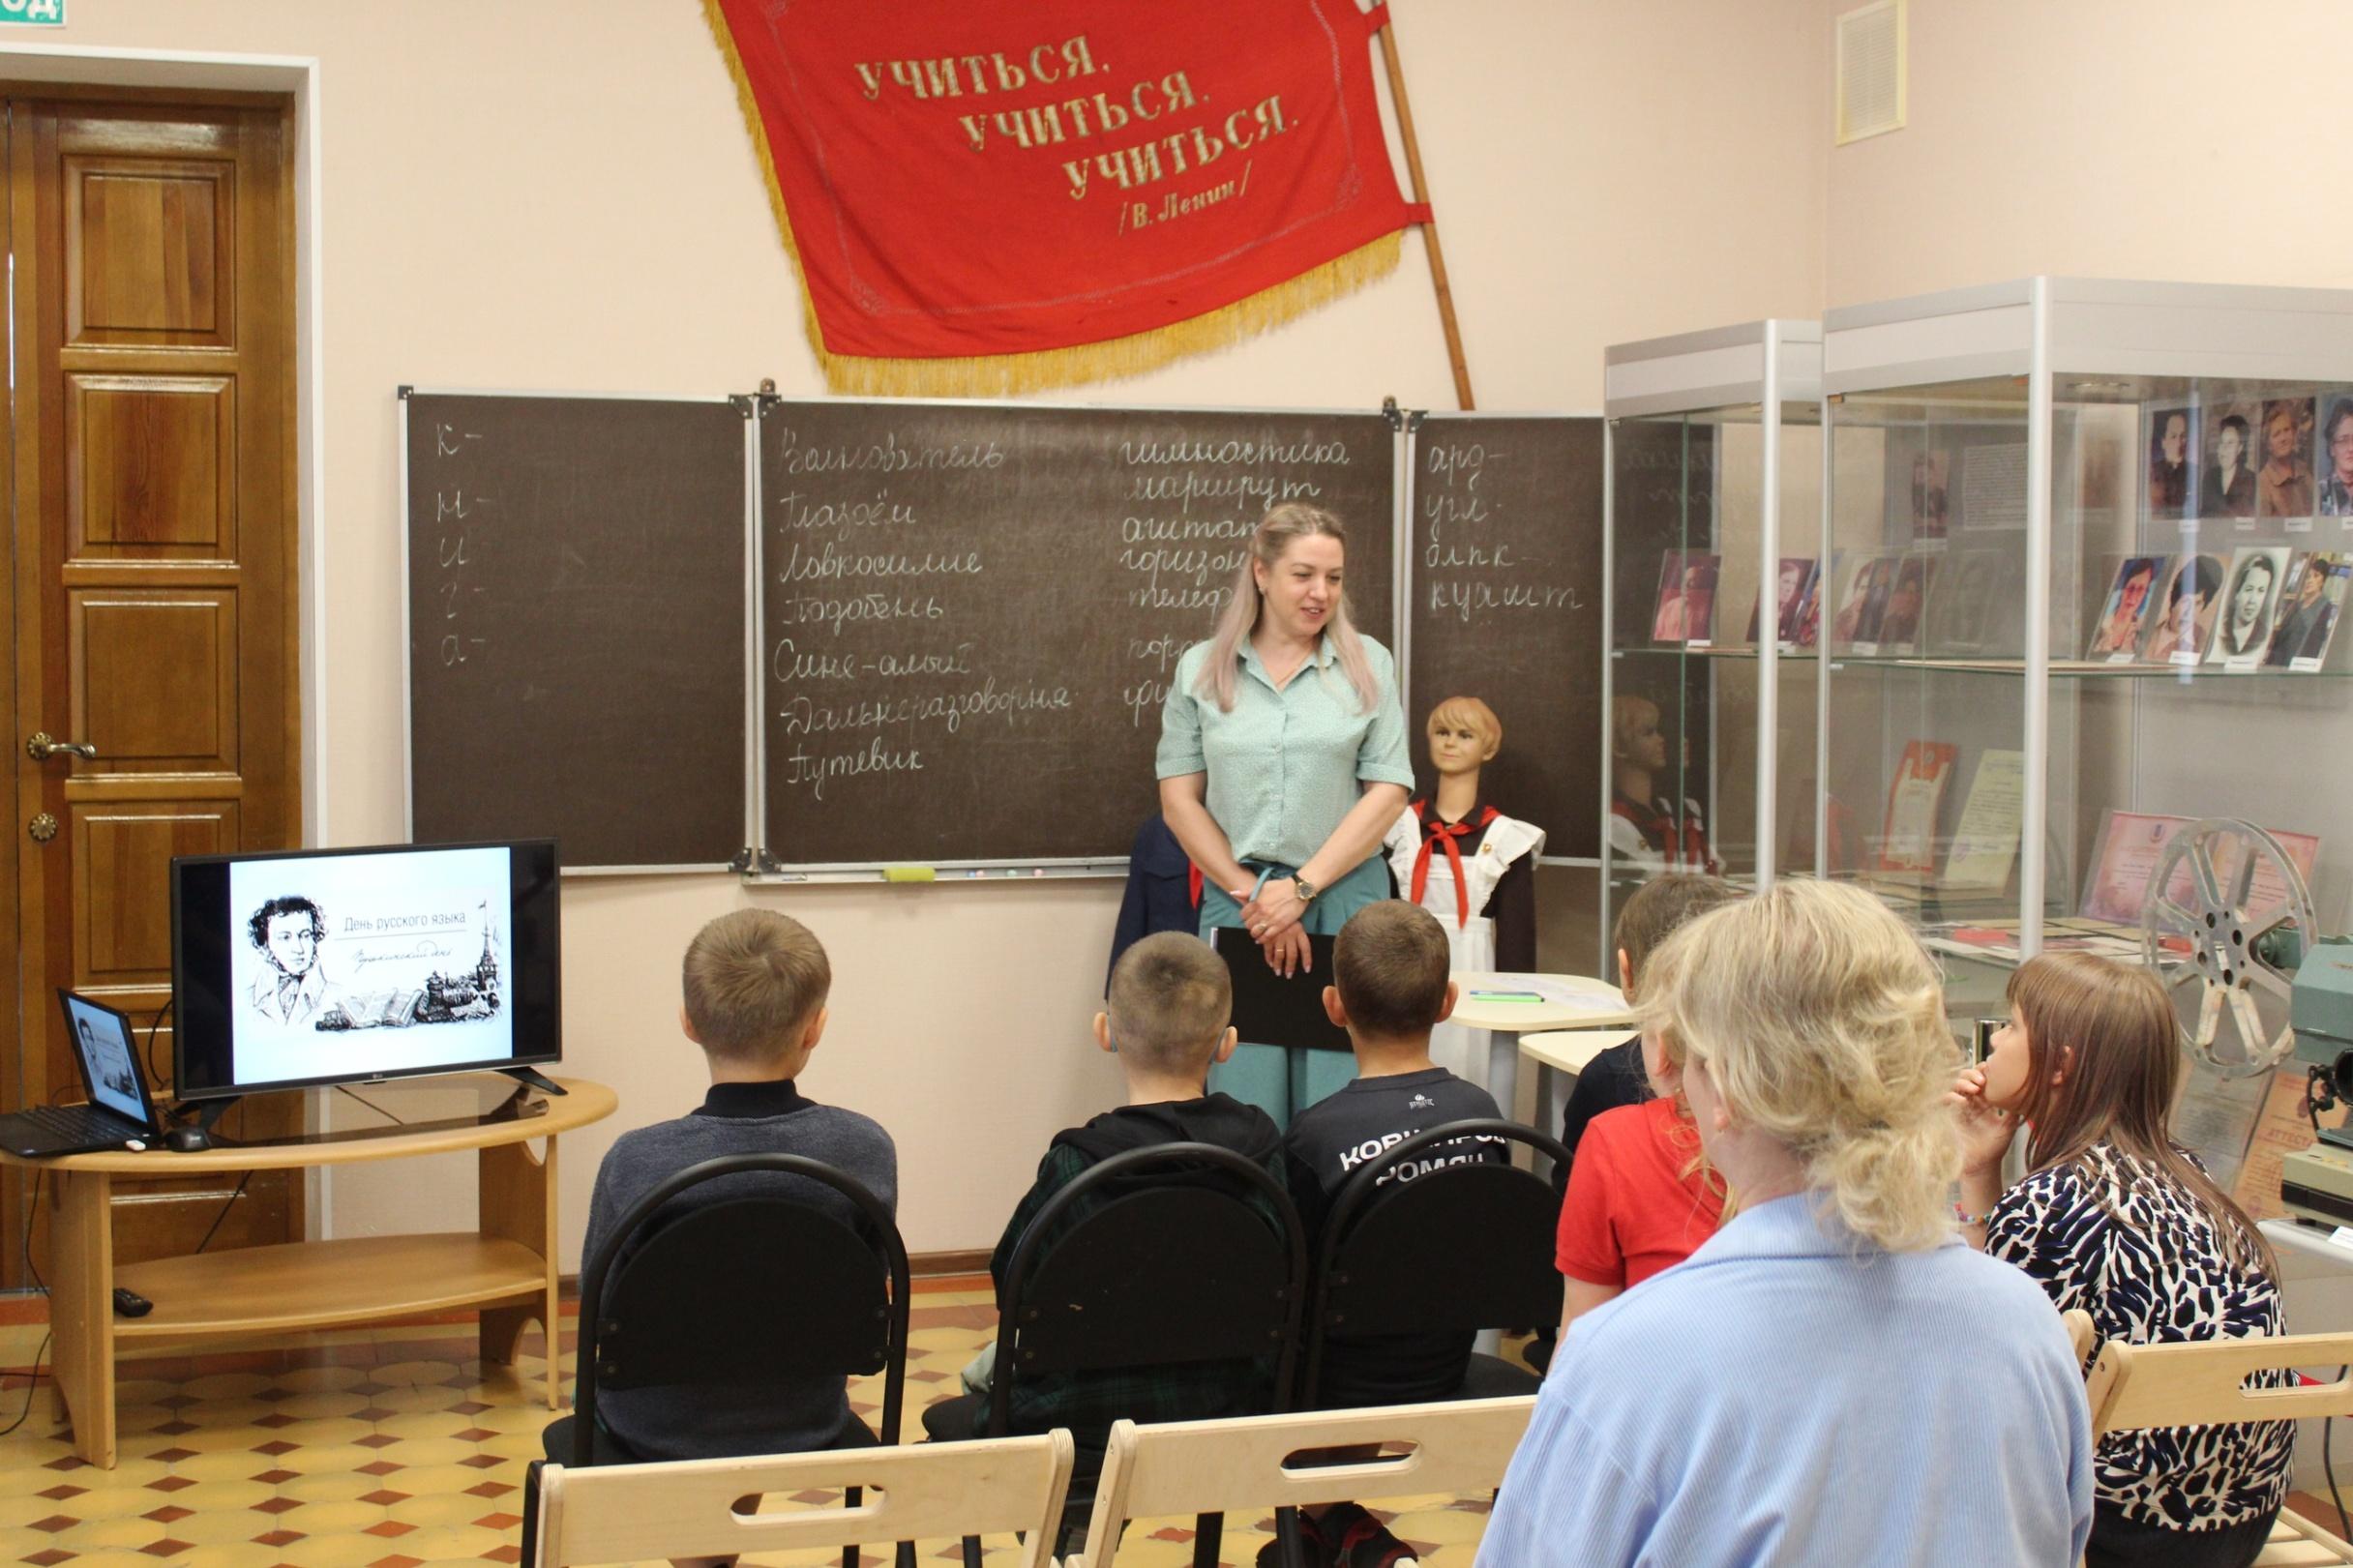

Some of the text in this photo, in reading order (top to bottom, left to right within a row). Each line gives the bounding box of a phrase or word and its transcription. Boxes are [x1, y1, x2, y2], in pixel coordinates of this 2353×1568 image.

[1119, 548, 1247, 588] горизон
[1129, 586, 1233, 626] телеф
[344, 912, 465, 932] День русского языка
